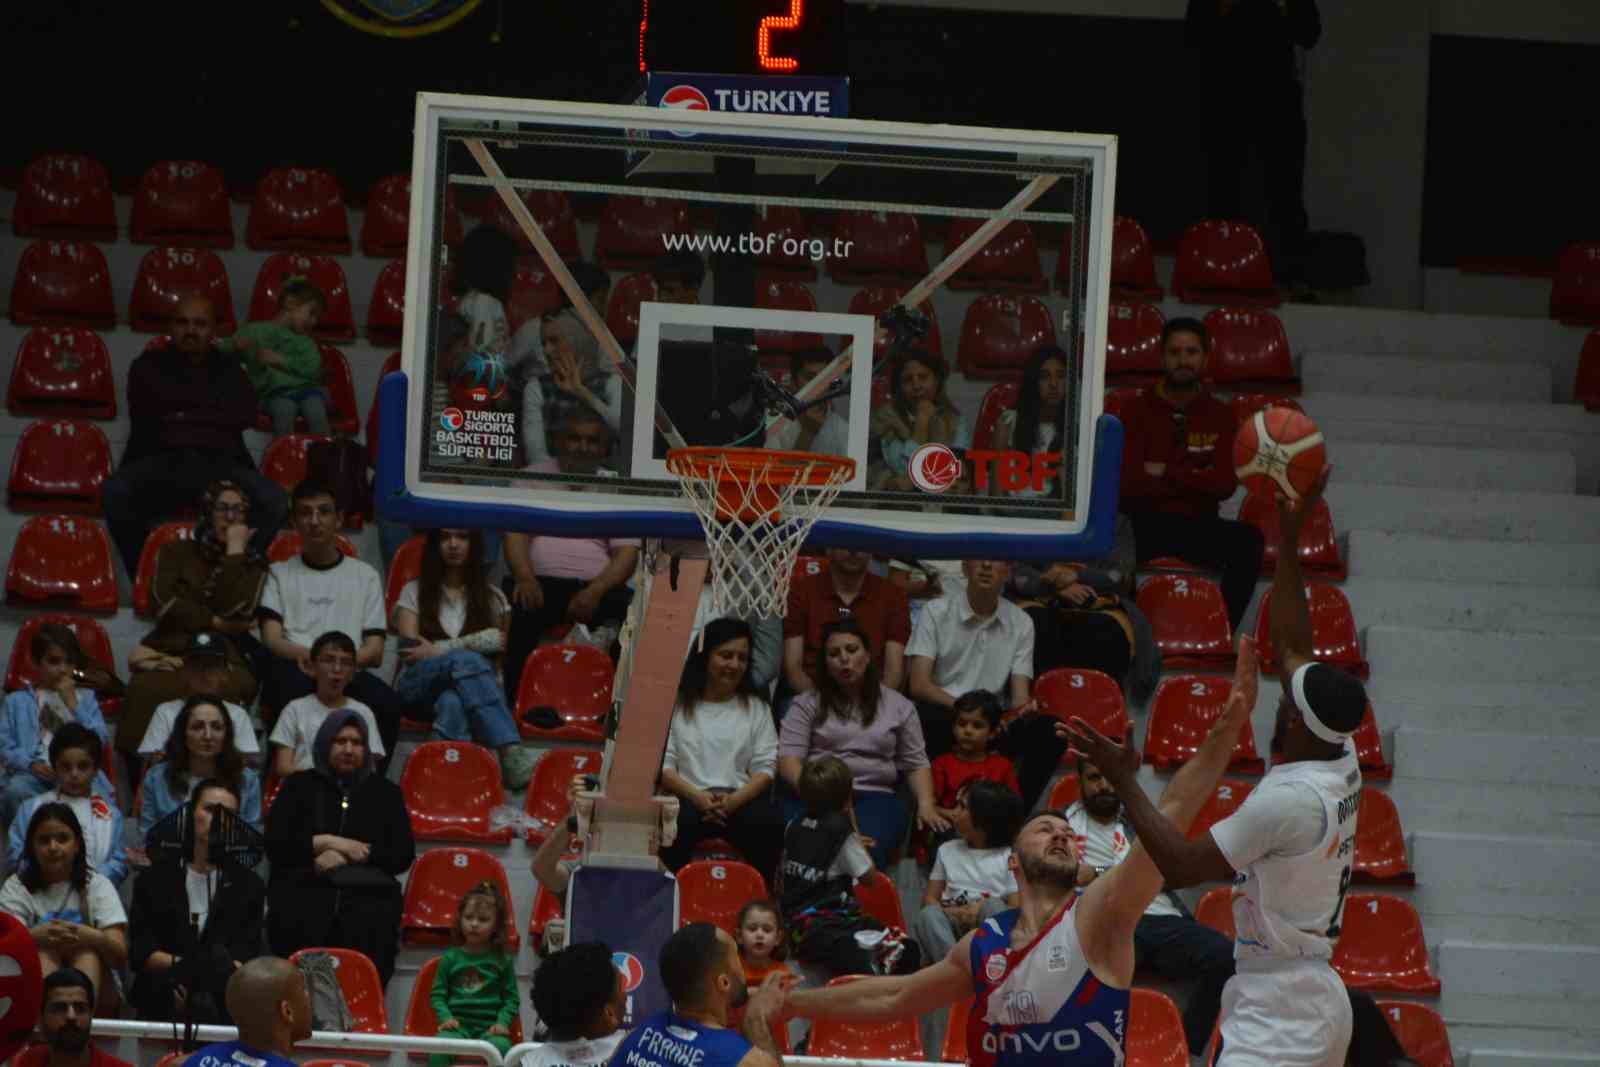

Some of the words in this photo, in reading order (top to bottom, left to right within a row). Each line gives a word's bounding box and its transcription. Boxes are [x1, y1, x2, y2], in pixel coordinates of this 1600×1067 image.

[758, 0, 800, 68] 2
[714, 88, 831, 113] TÜRKİYE
[435, 431, 518, 448] BASKETBOL
[437, 442, 484, 459] SÜPER
[964, 448, 1064, 492] TBF
[1173, 577, 1189, 593] 2
[561, 649, 577, 665] 7
[1070, 673, 1085, 688] 3
[1191, 682, 1208, 697] 2
[443, 746, 461, 763] 8
[573, 754, 589, 770] 7
[1216, 785, 1234, 801] 2
[452, 852, 470, 869] 8
[710, 865, 728, 881] 6
[1367, 899, 1380, 916] 1
